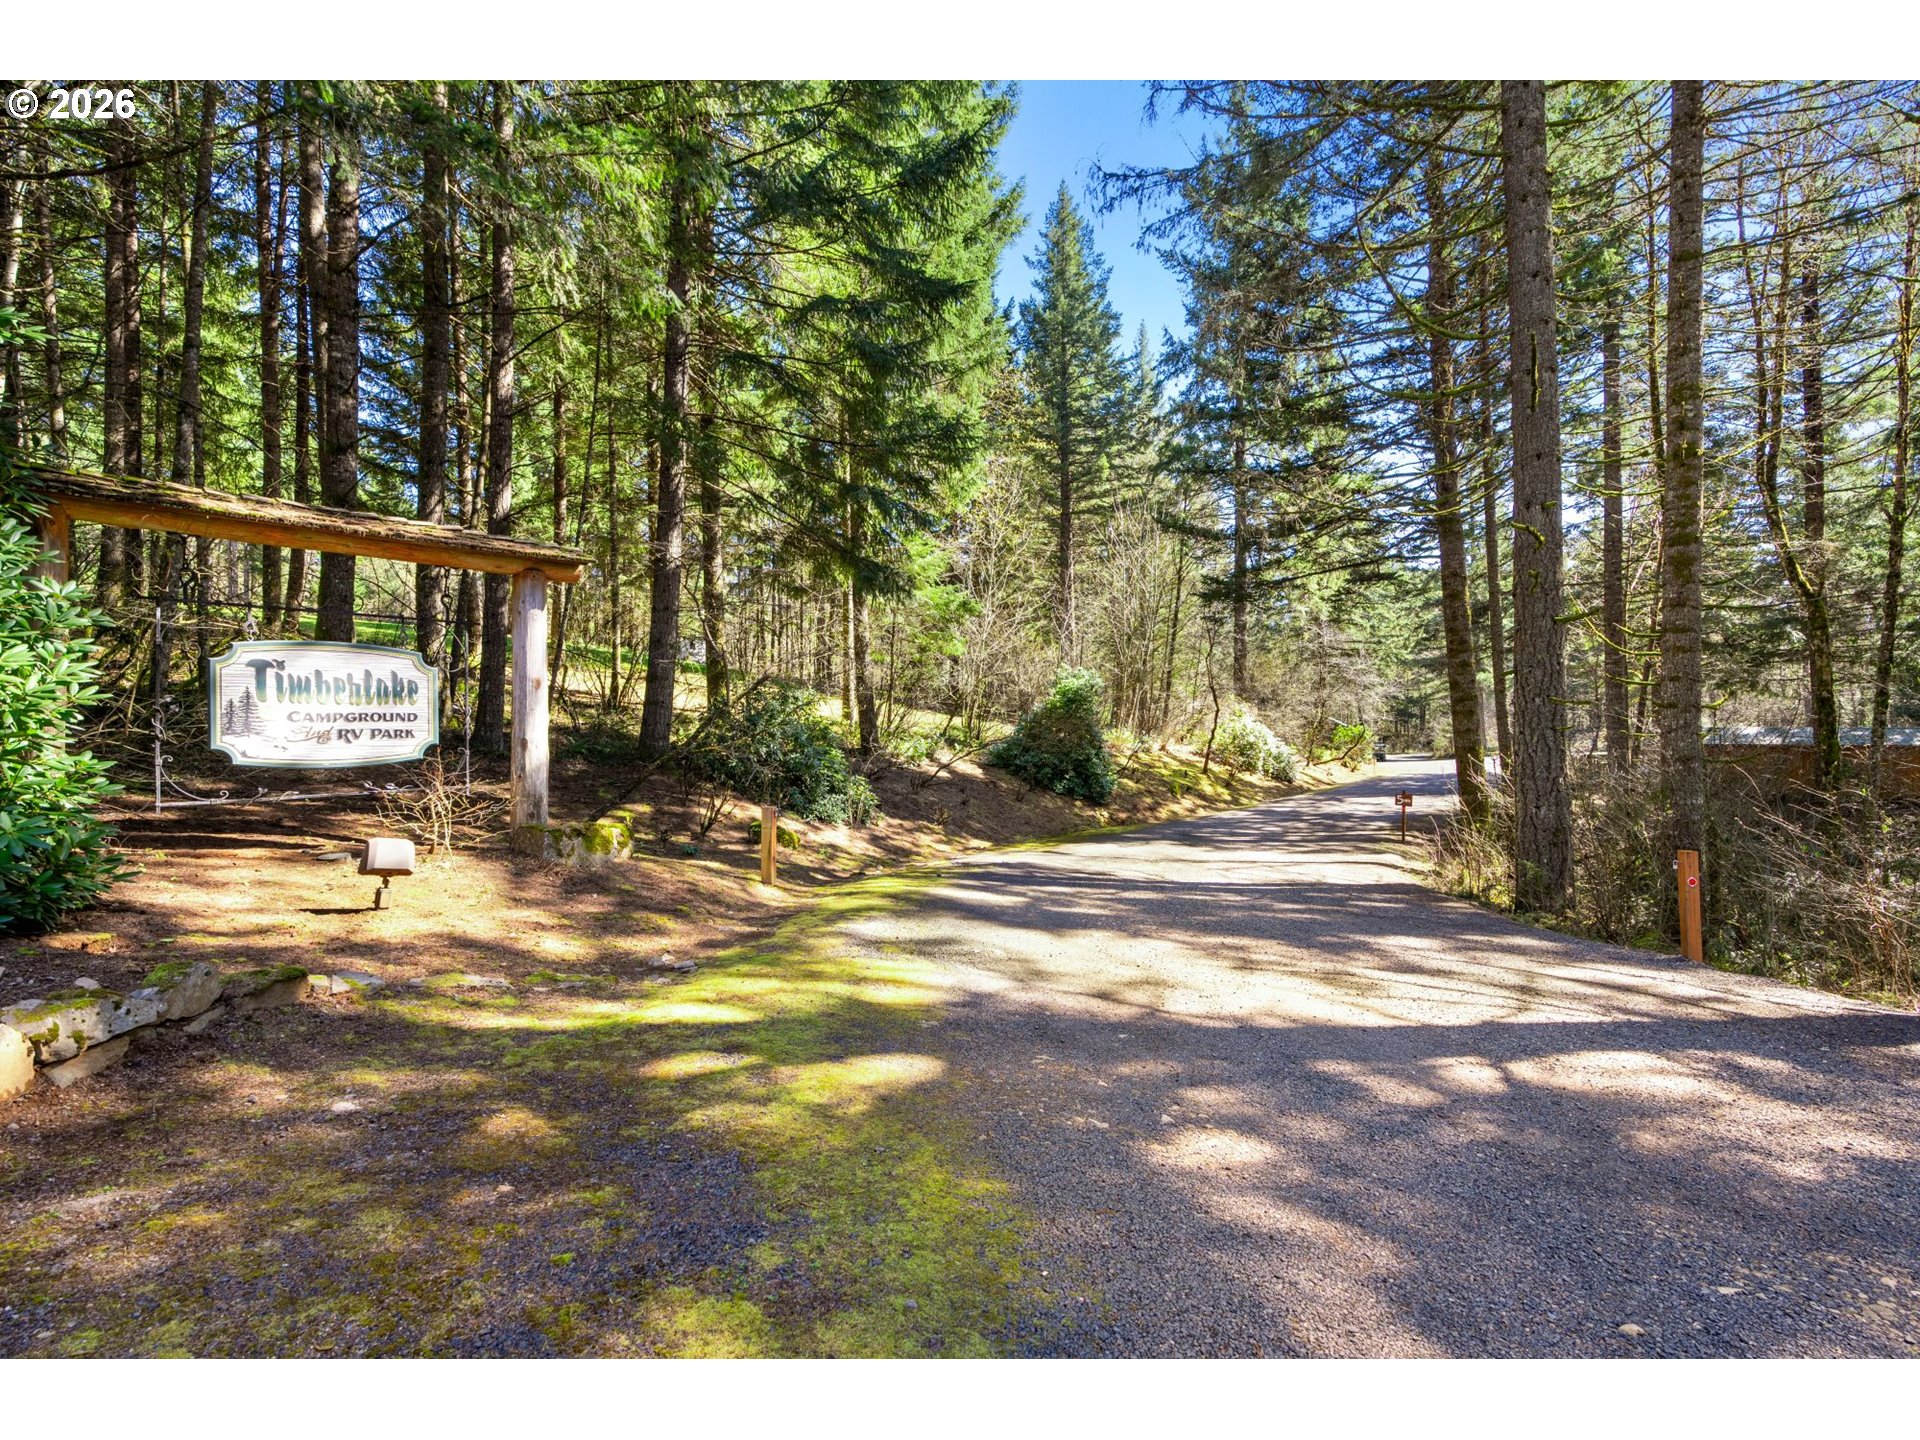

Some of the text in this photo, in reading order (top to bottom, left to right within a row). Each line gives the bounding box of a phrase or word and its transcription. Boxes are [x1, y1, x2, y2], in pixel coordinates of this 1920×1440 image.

[245, 658, 419, 706] Timberlake
[286, 711, 418, 723] CAMPGROUND
[336, 728, 364, 744] RV
[369, 728, 416, 740] PARK
